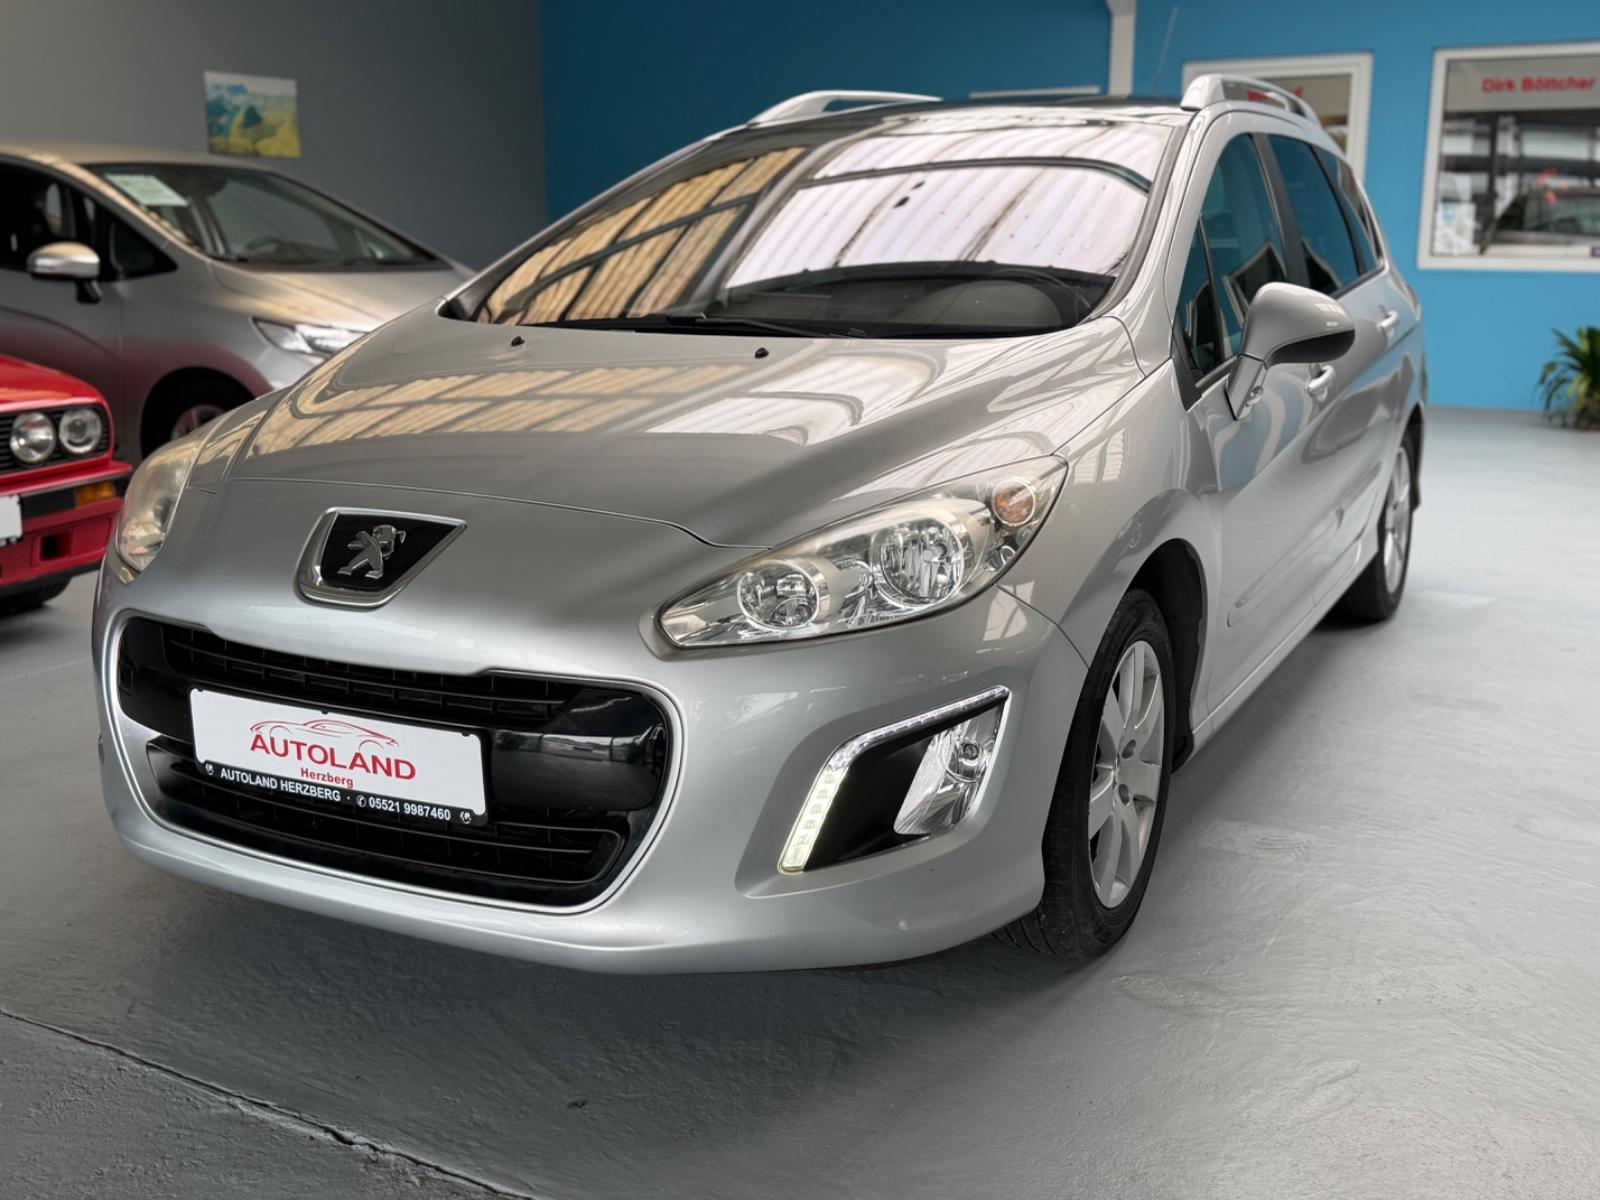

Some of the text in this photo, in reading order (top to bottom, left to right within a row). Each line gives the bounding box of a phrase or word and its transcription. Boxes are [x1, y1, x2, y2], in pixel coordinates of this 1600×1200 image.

[1481, 77, 1515, 93] Dirk
[250, 733, 417, 781] AUTOLAND
[220, 767, 452, 821] AUTOLAND HERZBERG 05521 9987460
[300, 767, 354, 789] Herzberg
